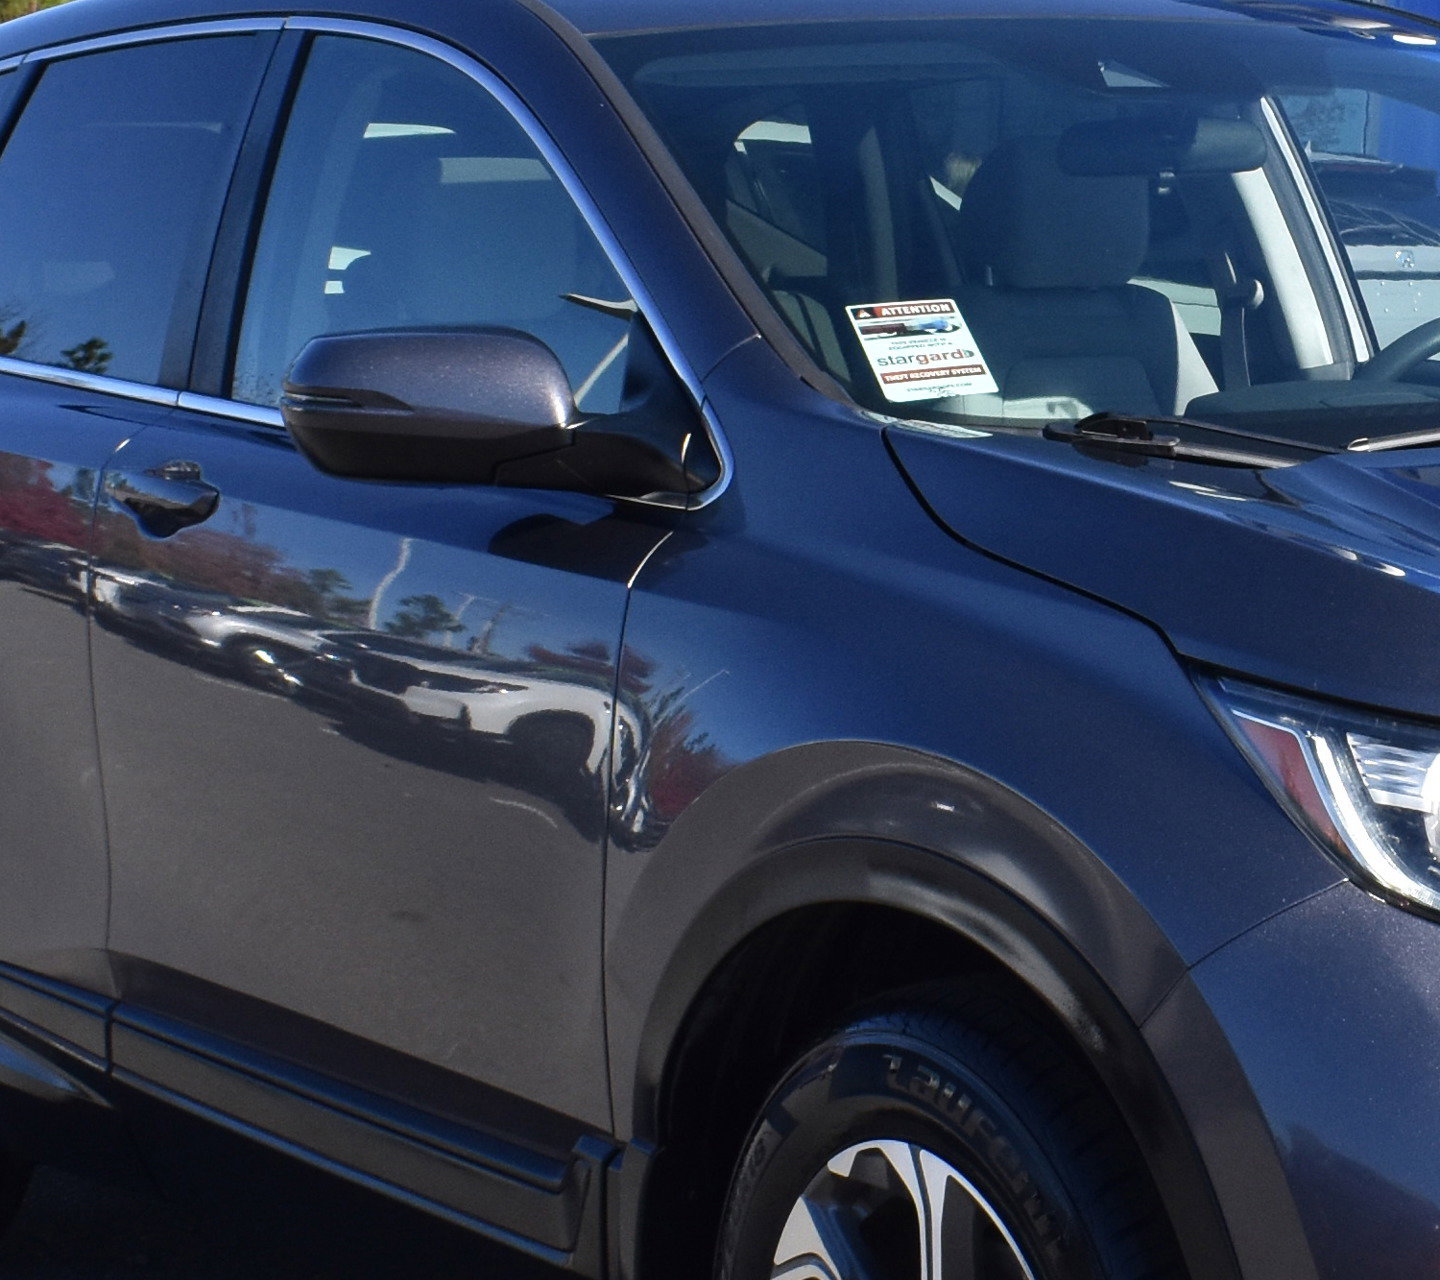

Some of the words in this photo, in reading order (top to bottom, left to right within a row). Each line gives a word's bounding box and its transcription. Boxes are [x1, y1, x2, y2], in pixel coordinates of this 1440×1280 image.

[881, 302, 952, 318] ATTENTION
[877, 348, 965, 366] stargard
[909, 369, 952, 381] RECOVERY
